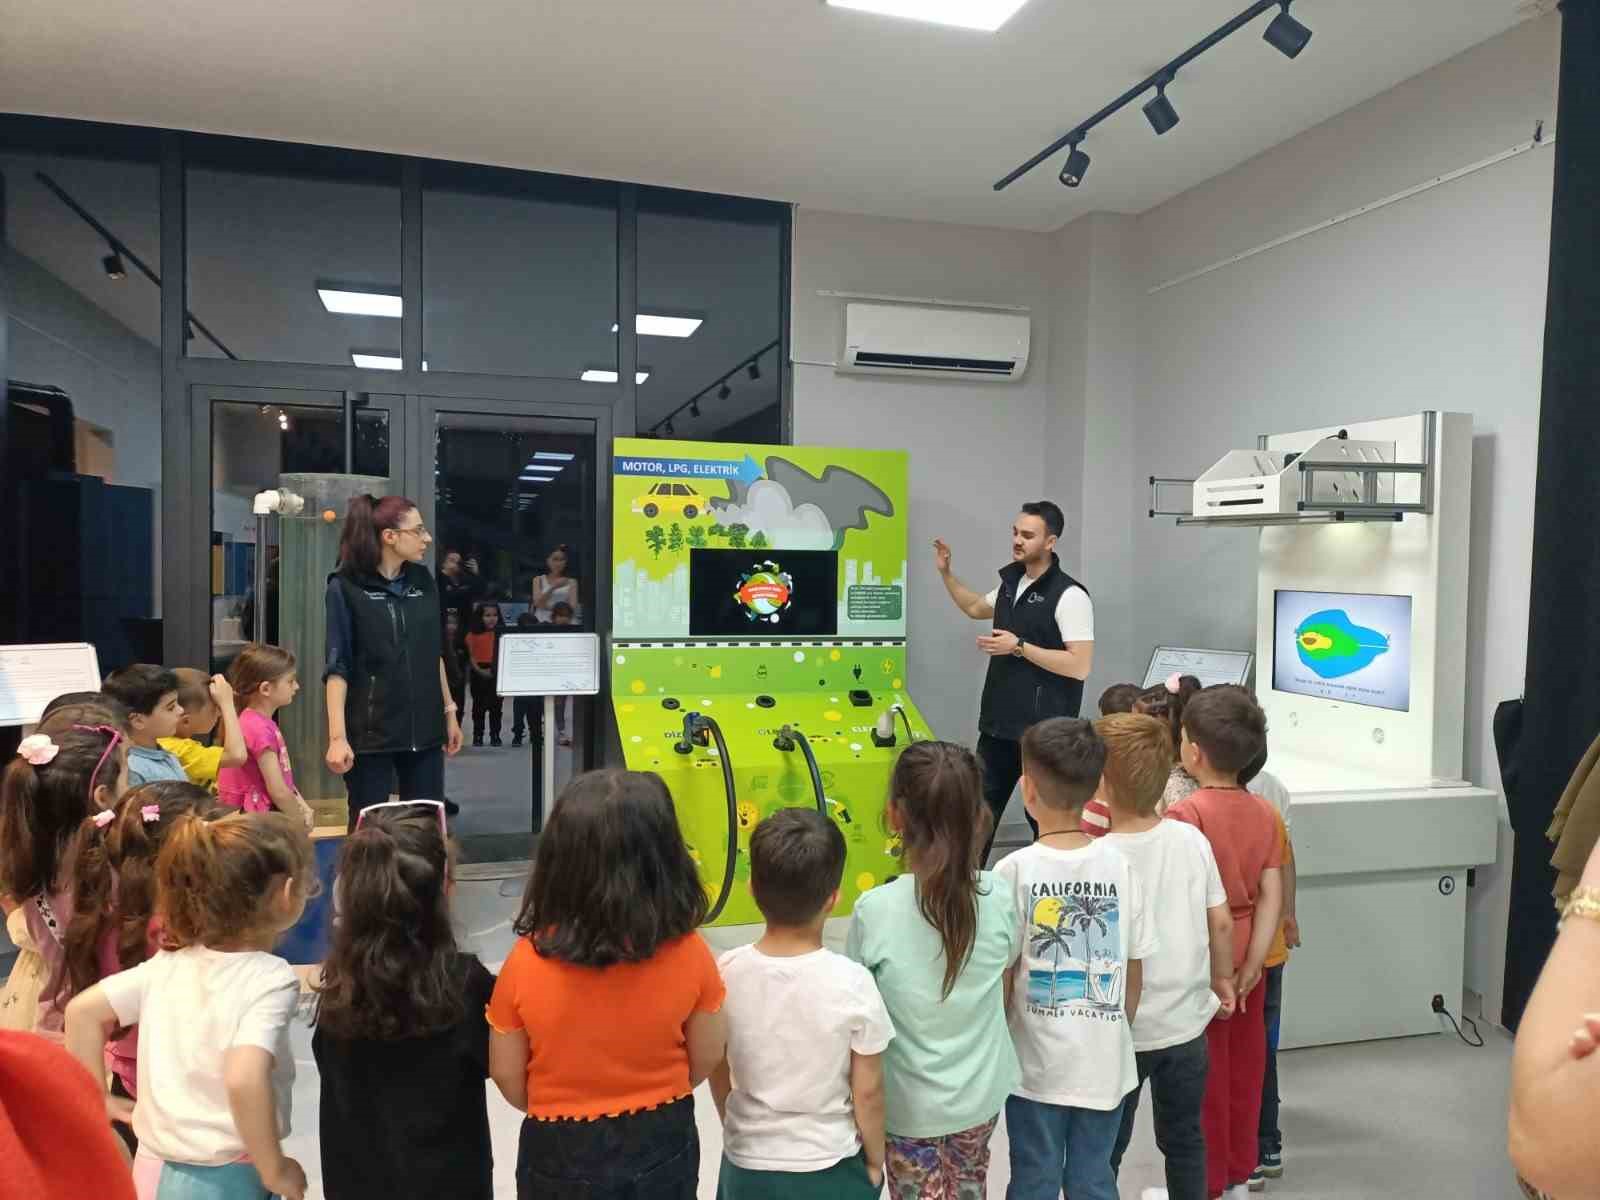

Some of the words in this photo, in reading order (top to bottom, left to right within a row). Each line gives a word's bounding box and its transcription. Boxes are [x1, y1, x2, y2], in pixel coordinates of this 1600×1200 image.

[622, 461, 665, 474] MOTOR,
[668, 463, 690, 474] LPG,
[693, 463, 739, 475] ELEKTRİK
[1031, 882, 1118, 897] CALIFORNIA
[1026, 1003, 1065, 1018] SUMMER
[1070, 1008, 1125, 1022] VACATION
